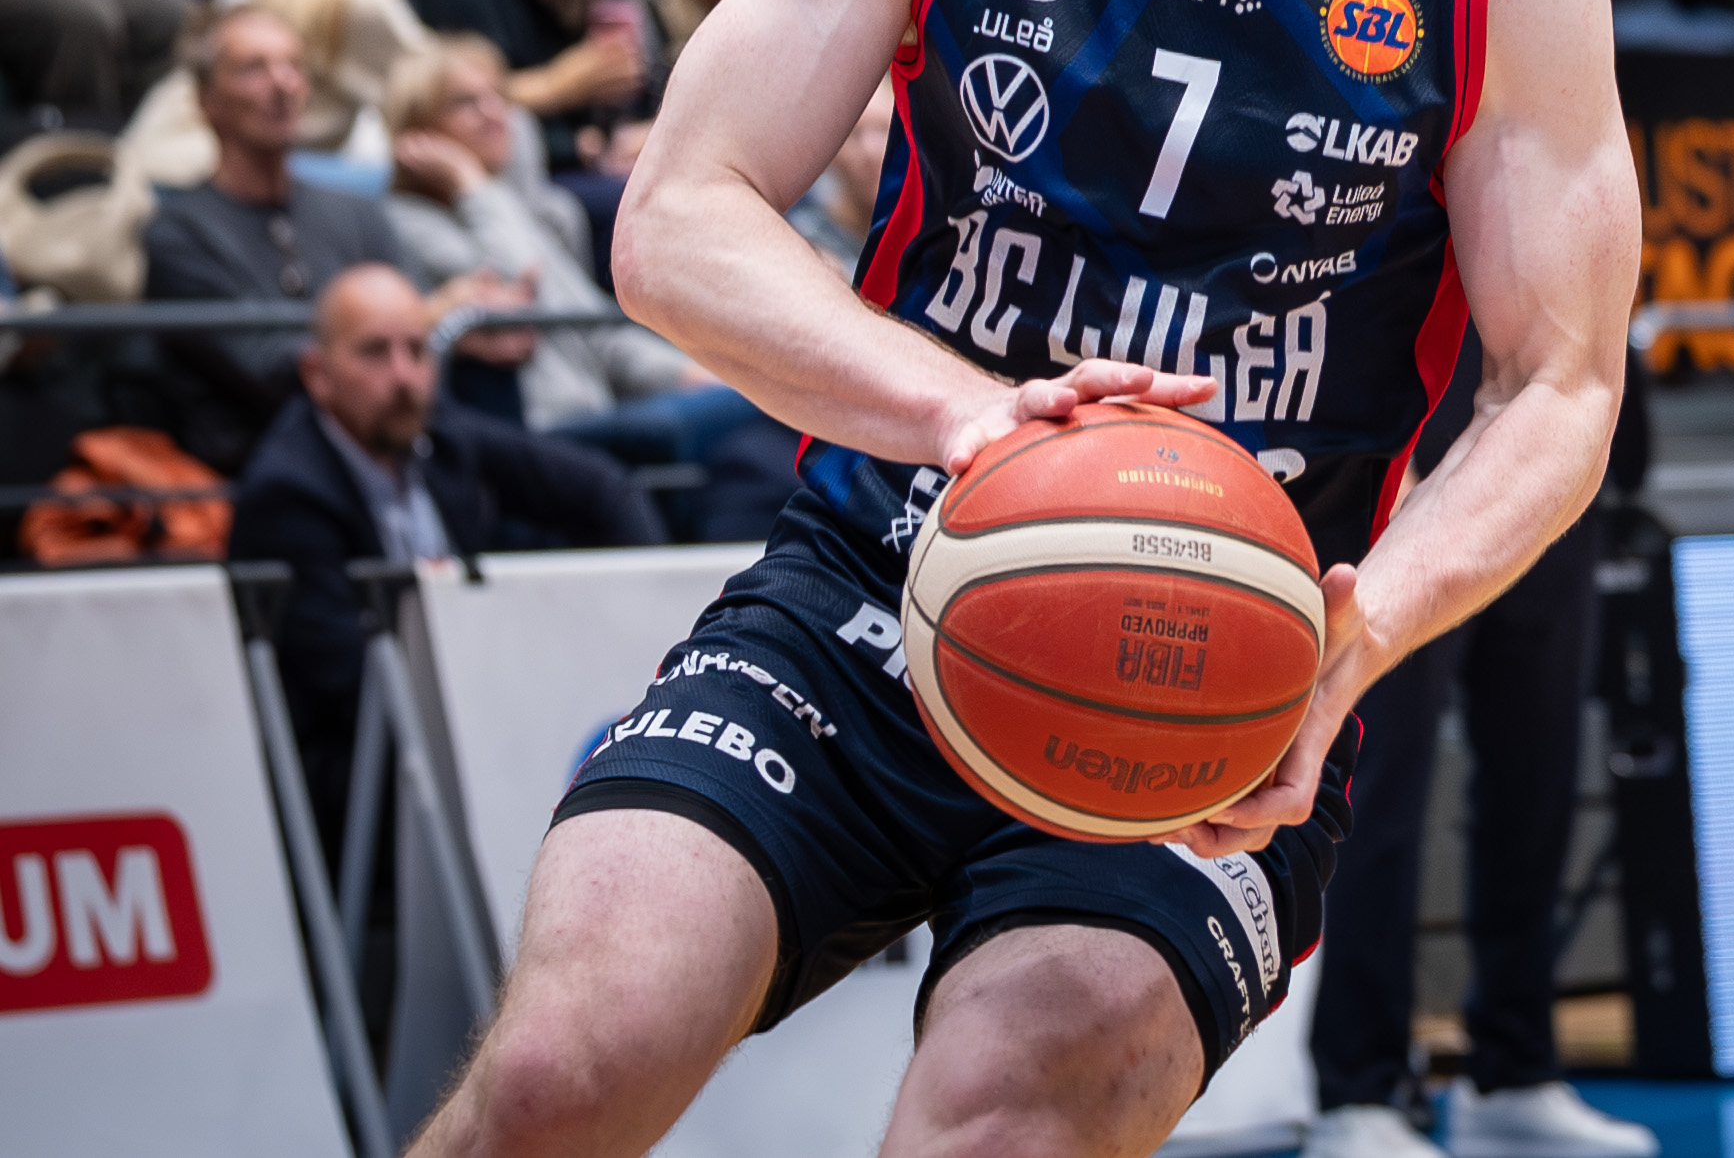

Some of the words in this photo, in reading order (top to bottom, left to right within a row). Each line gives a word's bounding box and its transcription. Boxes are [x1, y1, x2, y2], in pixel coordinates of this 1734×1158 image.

[1332, 0, 1411, 50] SBL
[1138, 48, 1222, 219] 7
[1322, 118, 1420, 168] LKAB
[1325, 201, 1384, 226] Energi
[1332, 181, 1385, 205] Luleå
[924, 208, 1042, 356] BC
[1281, 249, 1357, 284] NYAB
[1120, 614, 1209, 643] APPROVED
[1116, 637, 1207, 692] FIBA
[593, 708, 796, 794] ULEBO
[1043, 734, 1229, 795] molten
[1206, 915, 1251, 1015] CRAFT
